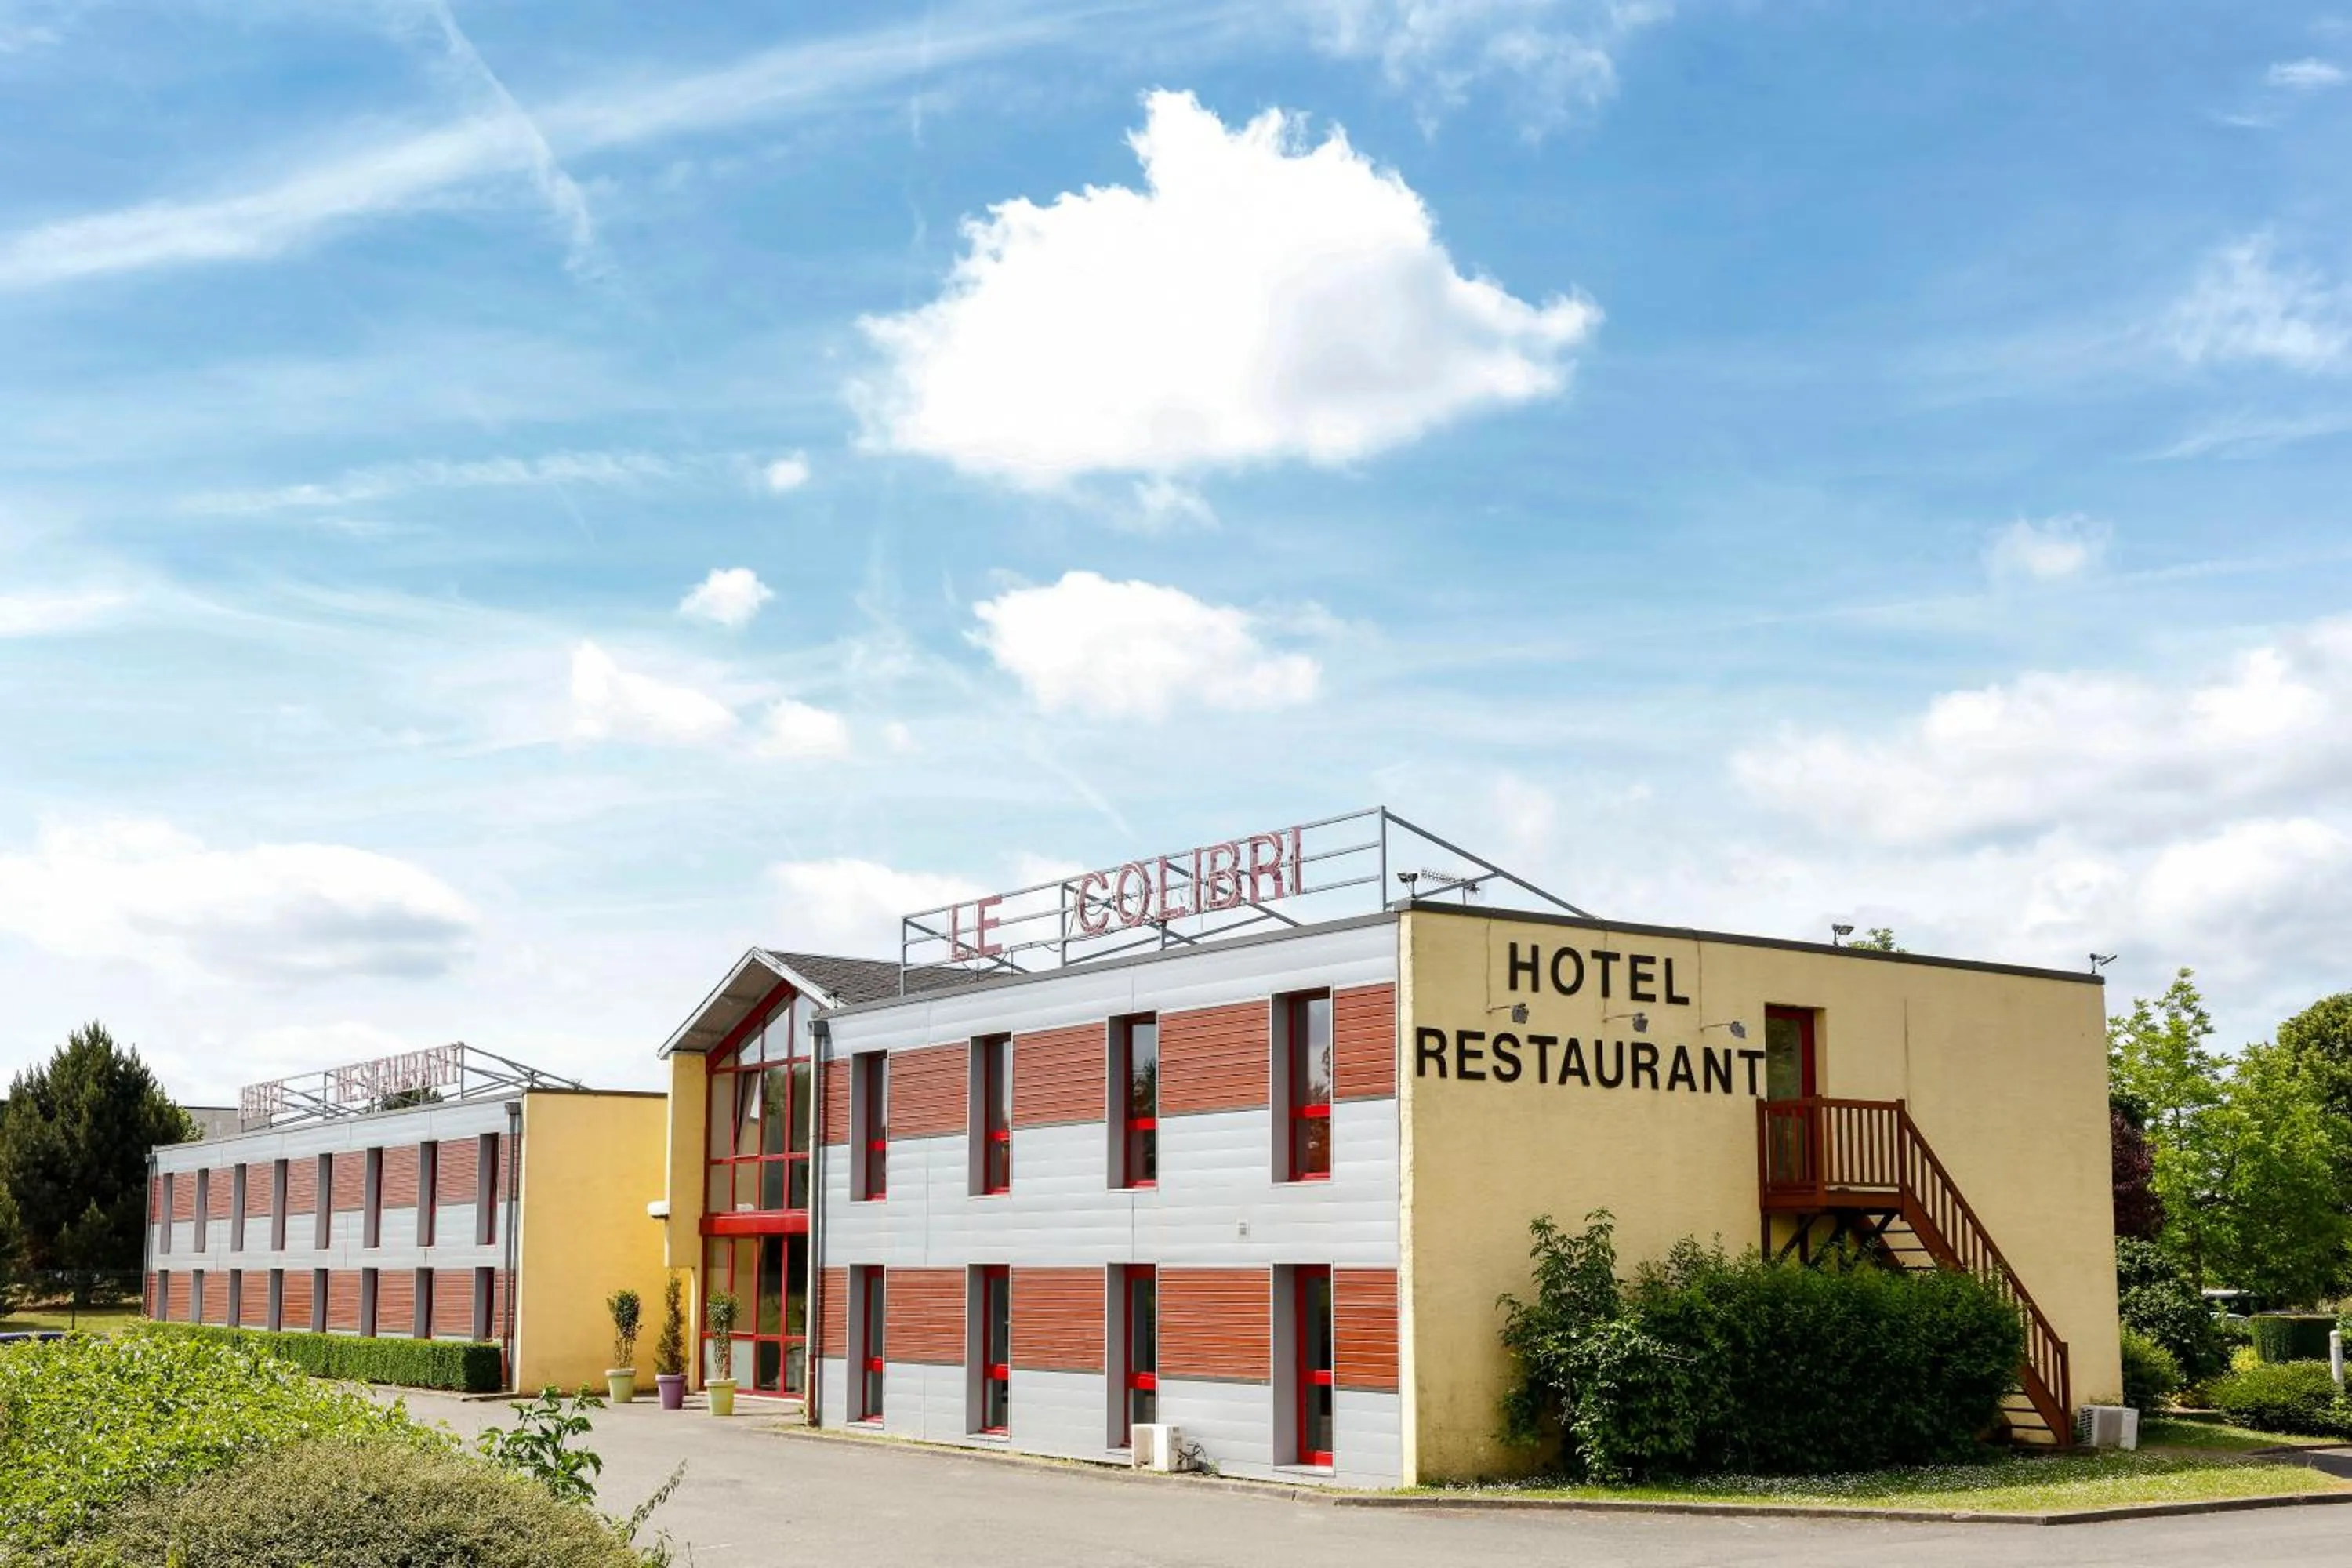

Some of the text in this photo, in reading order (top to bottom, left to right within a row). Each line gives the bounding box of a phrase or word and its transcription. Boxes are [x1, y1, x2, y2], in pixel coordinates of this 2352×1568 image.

[950, 826, 1302, 962] LE COLIBRI
[1508, 942, 1690, 1005] HOTEL
[1416, 1026, 1766, 1095] RESTAURANT
